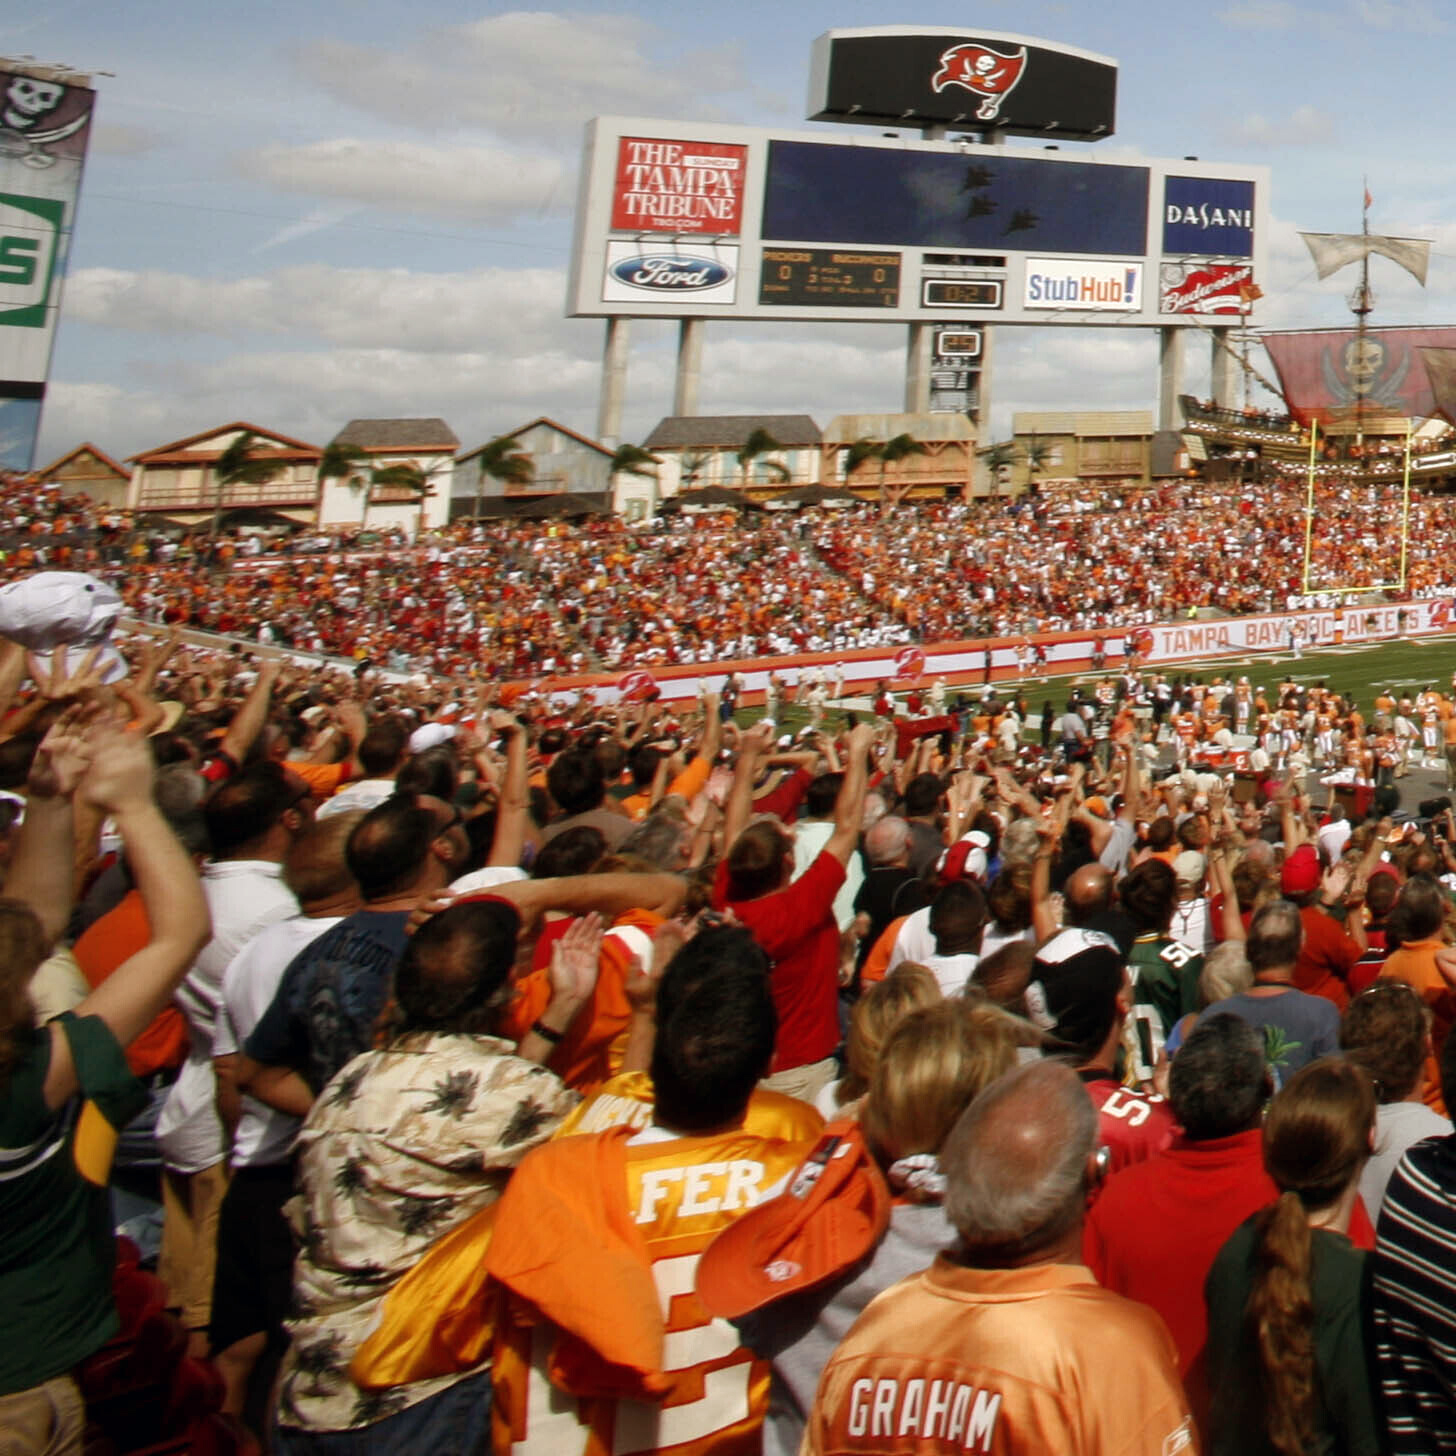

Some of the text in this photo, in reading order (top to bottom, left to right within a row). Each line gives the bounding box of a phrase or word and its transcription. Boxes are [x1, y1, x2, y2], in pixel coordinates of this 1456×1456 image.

[629, 142, 682, 166] THE
[626, 165, 736, 198] TAMPA
[623, 193, 735, 219] TRIBUNE
[1167, 203, 1252, 229] DASANI
[633, 258, 710, 286] Ford
[1029, 267, 1136, 303] StubHub!
[1161, 267, 1251, 313] Budweiser
[1162, 625, 1229, 654] TAMPA
[1245, 619, 1281, 646] BAY
[849, 1378, 1002, 1452] GRAHAM
